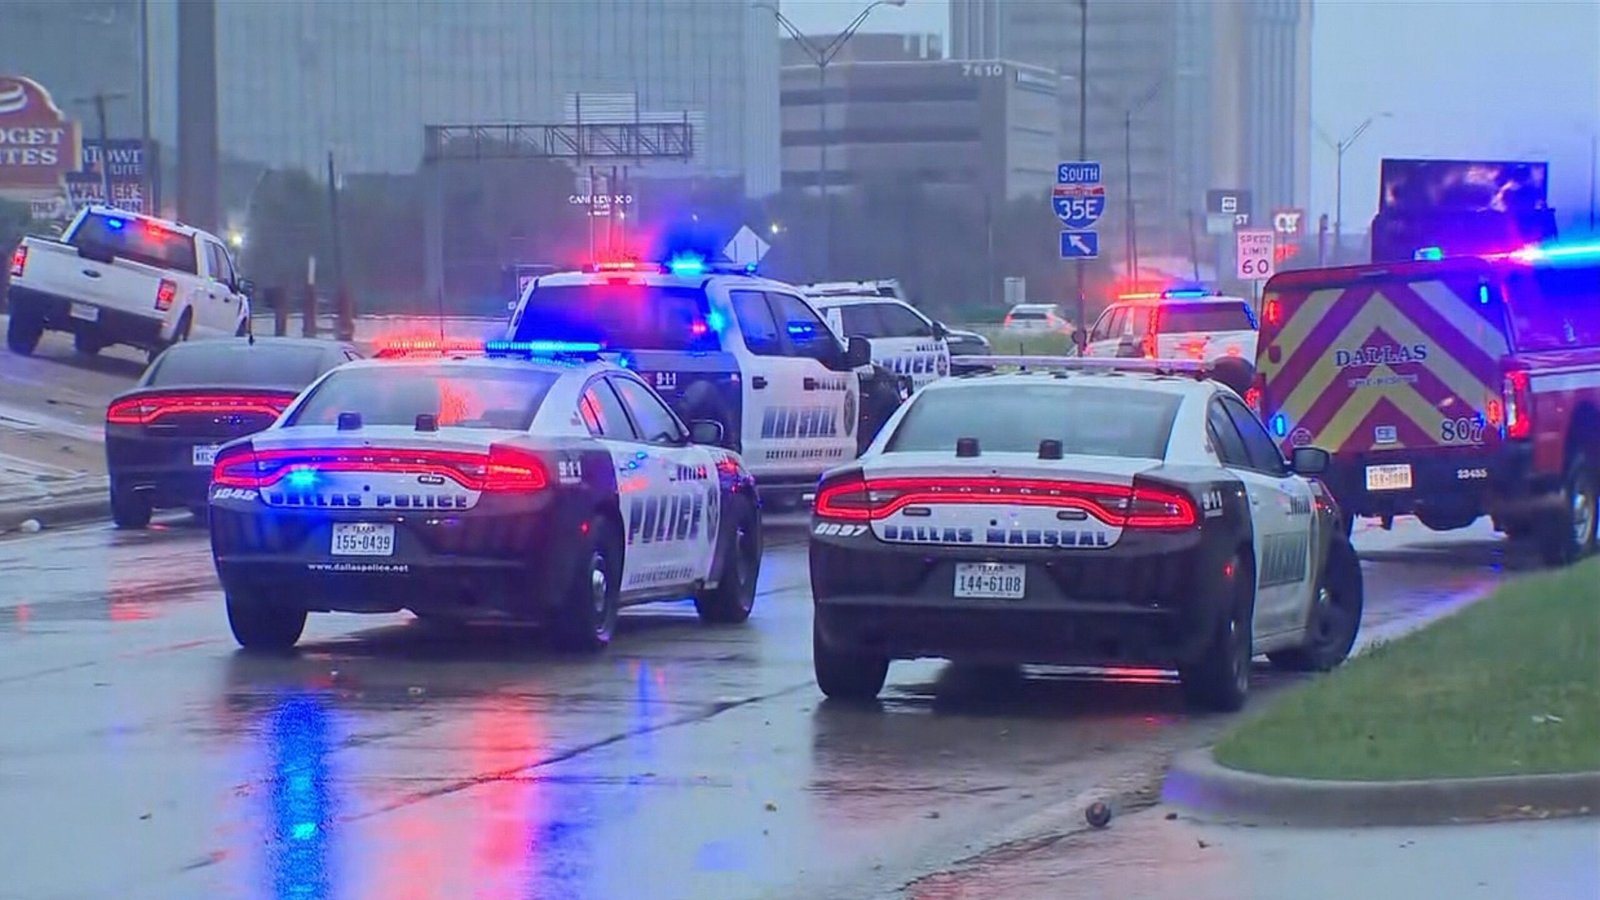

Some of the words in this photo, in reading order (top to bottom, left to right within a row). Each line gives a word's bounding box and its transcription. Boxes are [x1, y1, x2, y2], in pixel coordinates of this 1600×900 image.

[962, 64, 1003, 77] 7610
[1060, 166, 1098, 181] SOUTH
[1058, 199, 1098, 219] 35E
[1240, 234, 1272, 243] SPEED
[1242, 247, 1269, 256] LIMIT
[1242, 259, 1269, 275] 60
[1336, 344, 1427, 367] DALLAS
[1441, 417, 1485, 443] 807
[269, 492, 362, 507] DALLAS
[376, 493, 468, 508] POLICE
[627, 494, 703, 545] POLICE
[884, 525, 974, 542] DALLAS
[986, 527, 1109, 546] MARSHAL
[307, 562, 409, 575] www.dallaspolice.net
